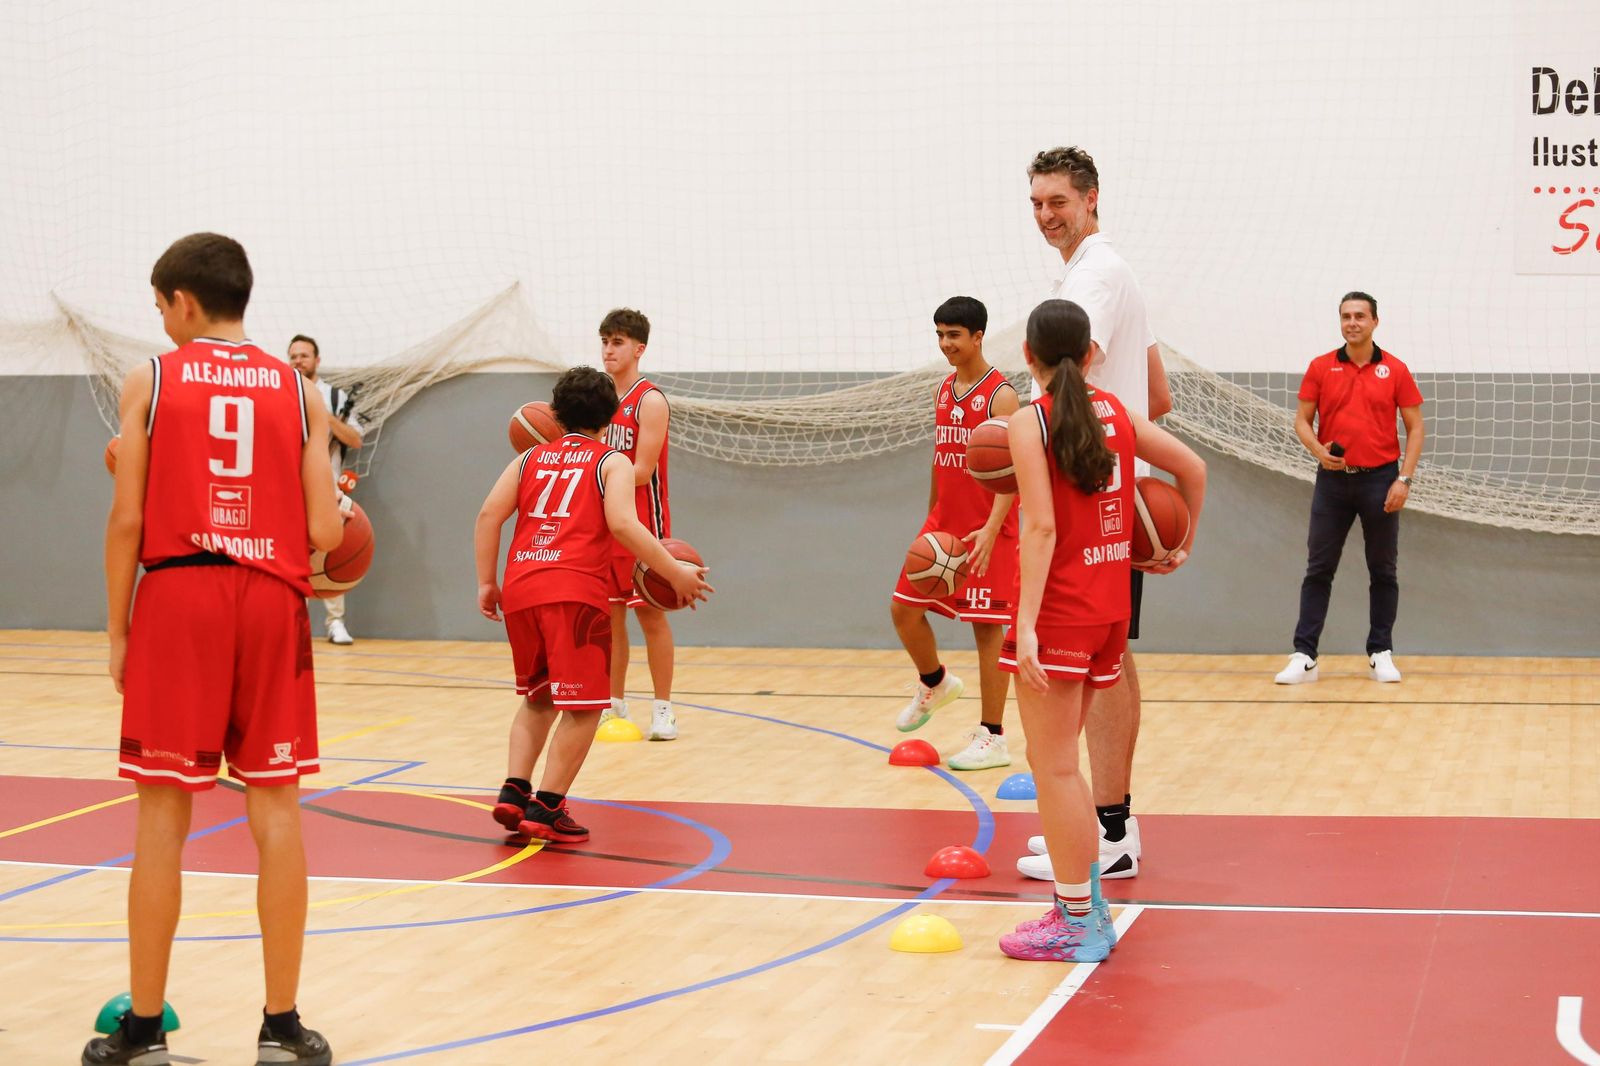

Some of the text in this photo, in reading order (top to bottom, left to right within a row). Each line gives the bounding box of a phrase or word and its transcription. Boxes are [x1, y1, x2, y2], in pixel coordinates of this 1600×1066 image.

[1551, 199, 1600, 255] S
[181, 362, 281, 389] ALEJANDRO
[208, 394, 254, 477] 9
[528, 468, 584, 518] 77
[212, 507, 247, 526] UBAGO
[965, 587, 992, 609] 45
